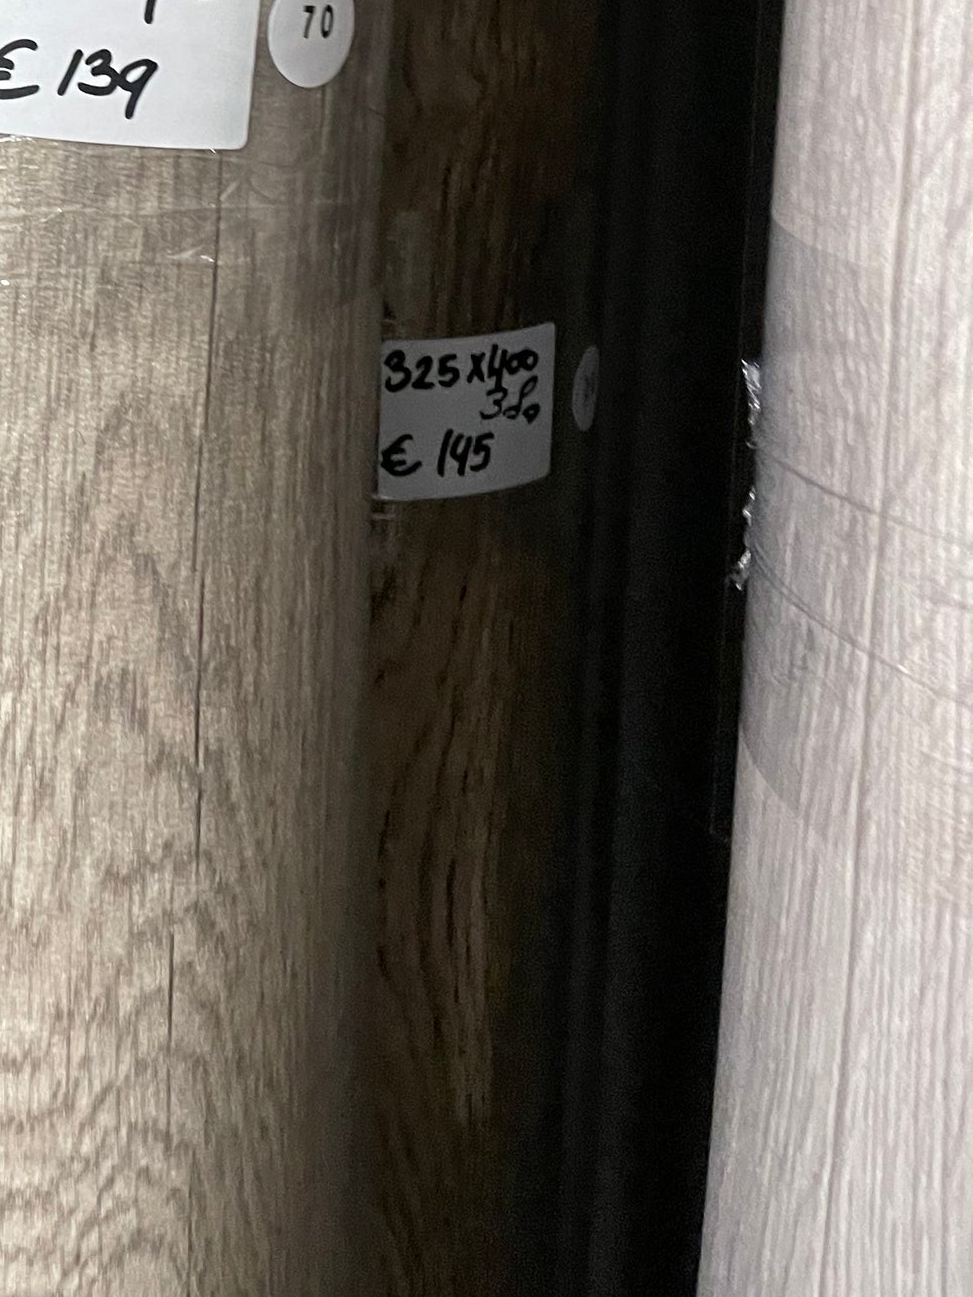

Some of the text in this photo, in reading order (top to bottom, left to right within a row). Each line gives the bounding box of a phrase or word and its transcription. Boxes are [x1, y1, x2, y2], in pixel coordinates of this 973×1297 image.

[302, 4, 335, 39] 70
[56, 48, 159, 120] 139
[436, 428, 495, 478] 145
